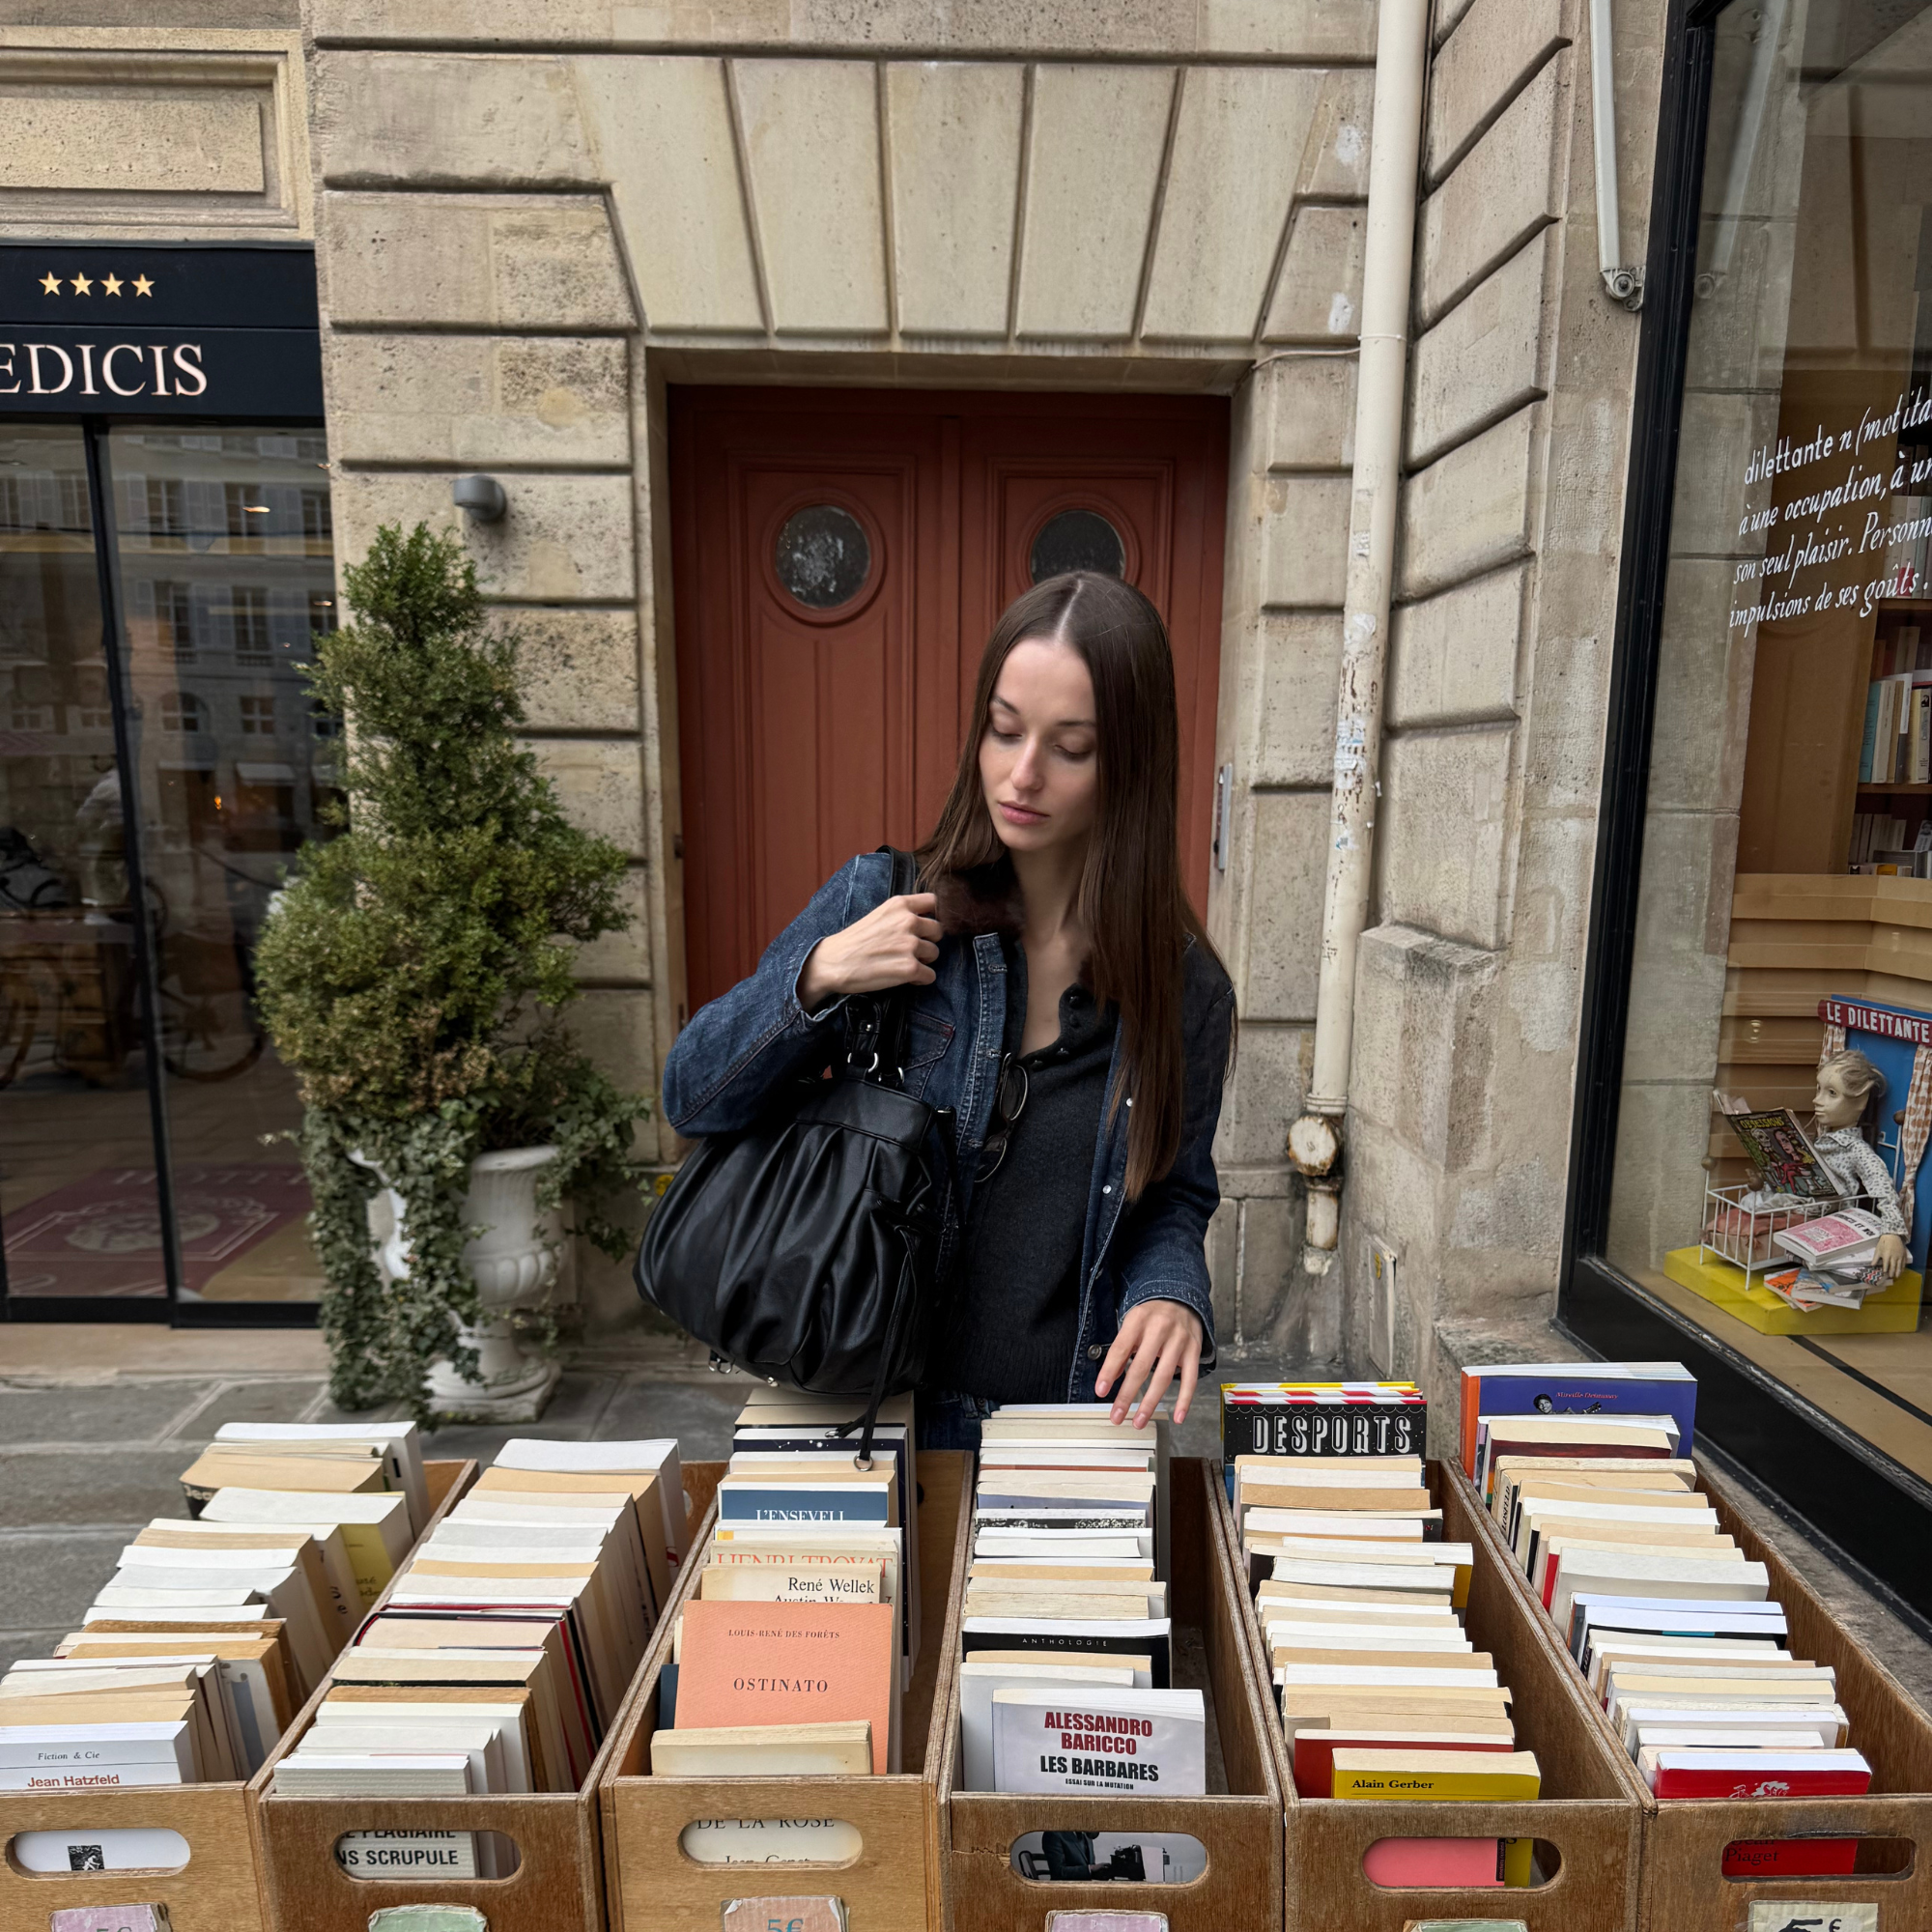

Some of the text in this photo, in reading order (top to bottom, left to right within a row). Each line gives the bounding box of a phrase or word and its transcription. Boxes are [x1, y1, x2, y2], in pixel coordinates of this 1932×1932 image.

[1744, 424, 1833, 485] dilettante
[1784, 465, 1888, 524] occupation,
[1889, 450, 1906, 491] à
[1733, 561, 1756, 584] son
[1759, 534, 1795, 578] seul
[1788, 526, 1853, 590] plaisir.
[1729, 590, 1811, 639] impulsions
[1814, 582, 1833, 612] de
[1834, 584, 1860, 610] ses
[1826, 1002, 1931, 1043] LE DILETTANTE
[1252, 1415, 1412, 1454] DESPORTS
[787, 1577, 875, 1594] René Wellek
[784, 1630, 803, 1638] DES
[805, 1629, 840, 1639] FORÊTS
[1022, 1637, 1107, 1647] ANTHOLOGIE
[733, 1677, 829, 1692] OSTINATO
[1044, 1712, 1153, 1737] ALESSANDRO
[1061, 1732, 1137, 1755] BARICCO
[38, 1752, 69, 1761] Fiction
[84, 1750, 100, 1759] Cie
[1039, 1755, 1159, 1782] LES BARBARES
[27, 1774, 121, 1788] Jean Hatzfeld
[1065, 1777, 1082, 1786] ESSAI
[1104, 1781, 1134, 1790] MUTATION
[1351, 1779, 1435, 1789] Alain Gerber
[366, 1850, 460, 1865] SCRUPULE
[1724, 1848, 1780, 1866] Piaget
